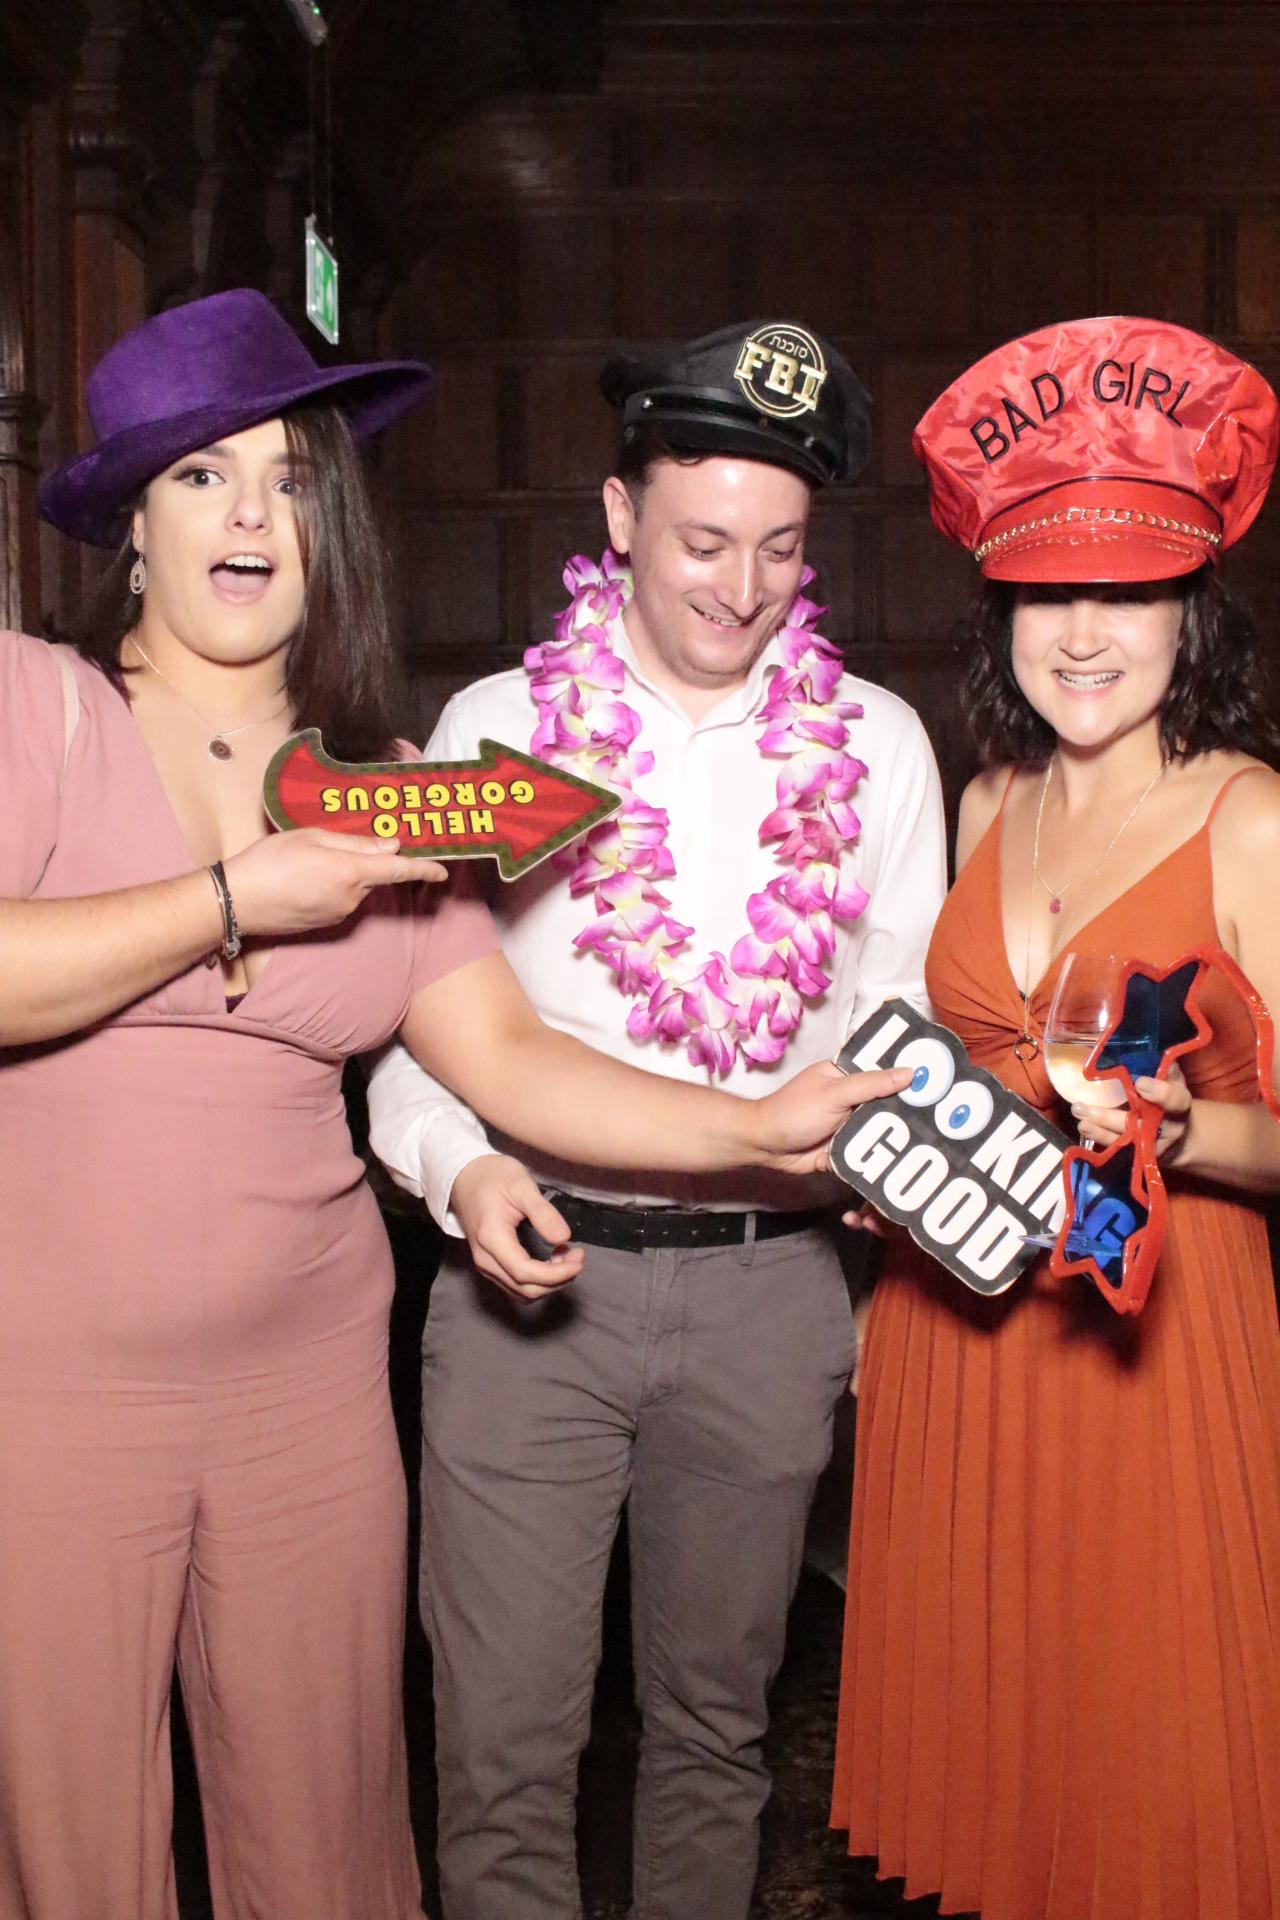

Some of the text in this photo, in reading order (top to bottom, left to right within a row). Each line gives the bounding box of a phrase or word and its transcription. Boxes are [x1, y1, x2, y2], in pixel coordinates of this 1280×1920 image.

[769, 336, 808, 358] סוכנת
[734, 337, 827, 411] FBI
[970, 359, 1190, 464] BAD GIRL
[321, 780, 535, 812] GORGEOUS
[371, 809, 495, 838] HELLO
[843, 1111, 1028, 1281] GOOD
